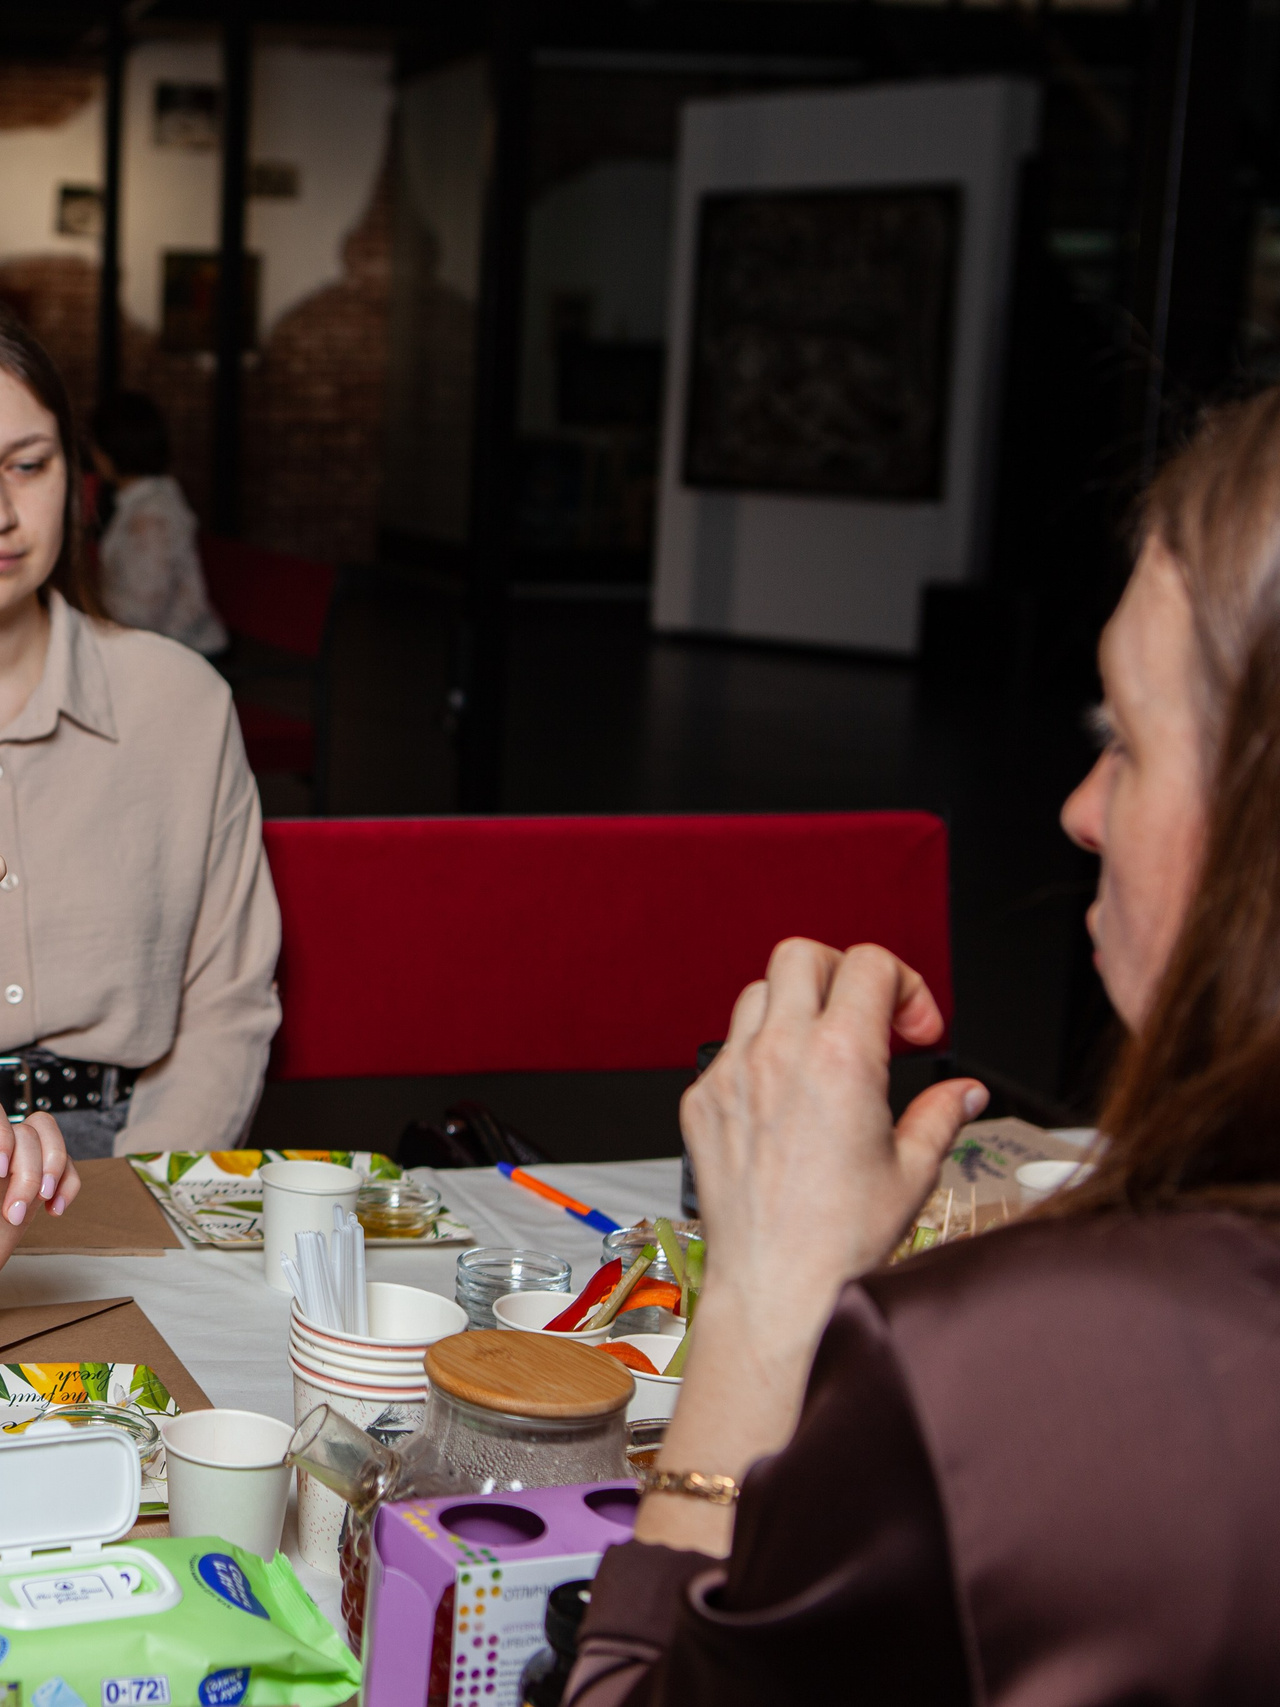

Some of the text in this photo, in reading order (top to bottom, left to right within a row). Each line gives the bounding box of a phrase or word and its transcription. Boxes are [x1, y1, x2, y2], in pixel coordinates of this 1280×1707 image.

[56, 1363, 116, 1392] fresh
[9, 1384, 90, 1407] the fruit
[132, 1679, 160, 1701] 72
